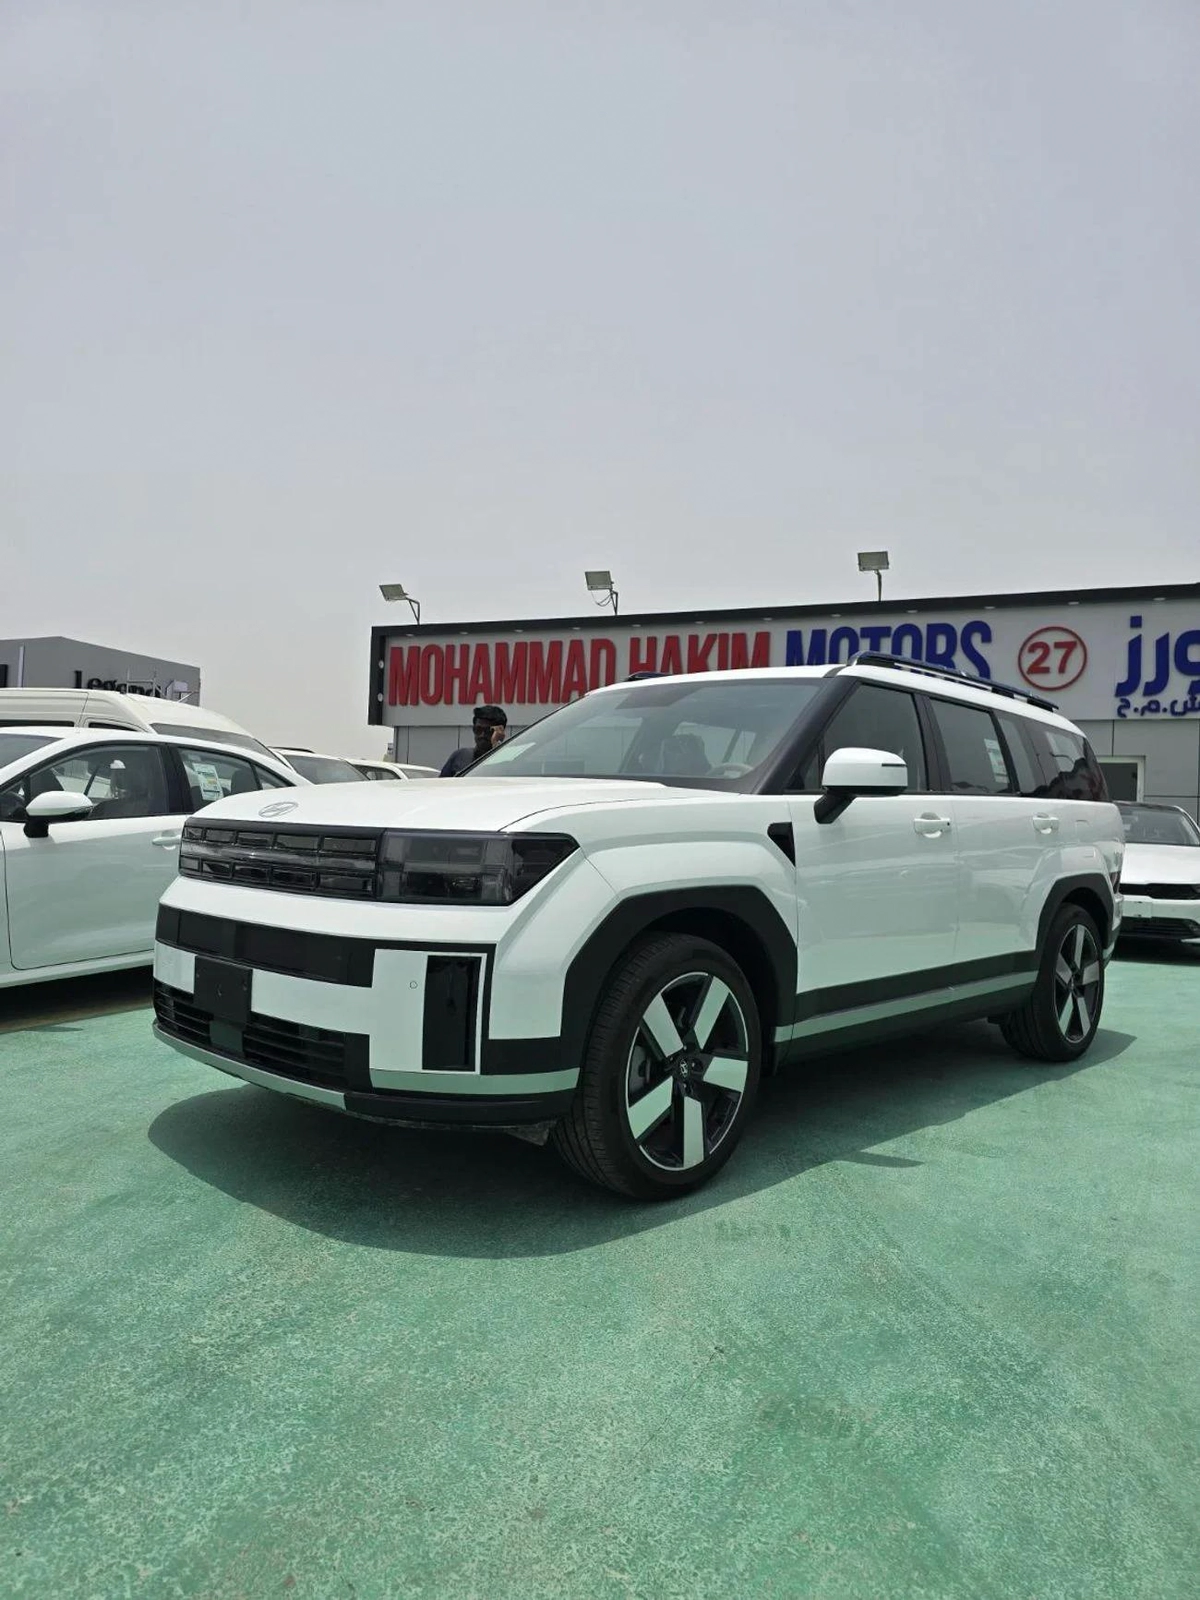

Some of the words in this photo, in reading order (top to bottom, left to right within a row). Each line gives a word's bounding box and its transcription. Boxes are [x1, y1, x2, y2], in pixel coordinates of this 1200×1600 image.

[388, 638, 617, 706] MOHAMMAD
[629, 631, 771, 675] HAKIM
[786, 620, 992, 680] MOTORS
[1026, 641, 1078, 675] 27
